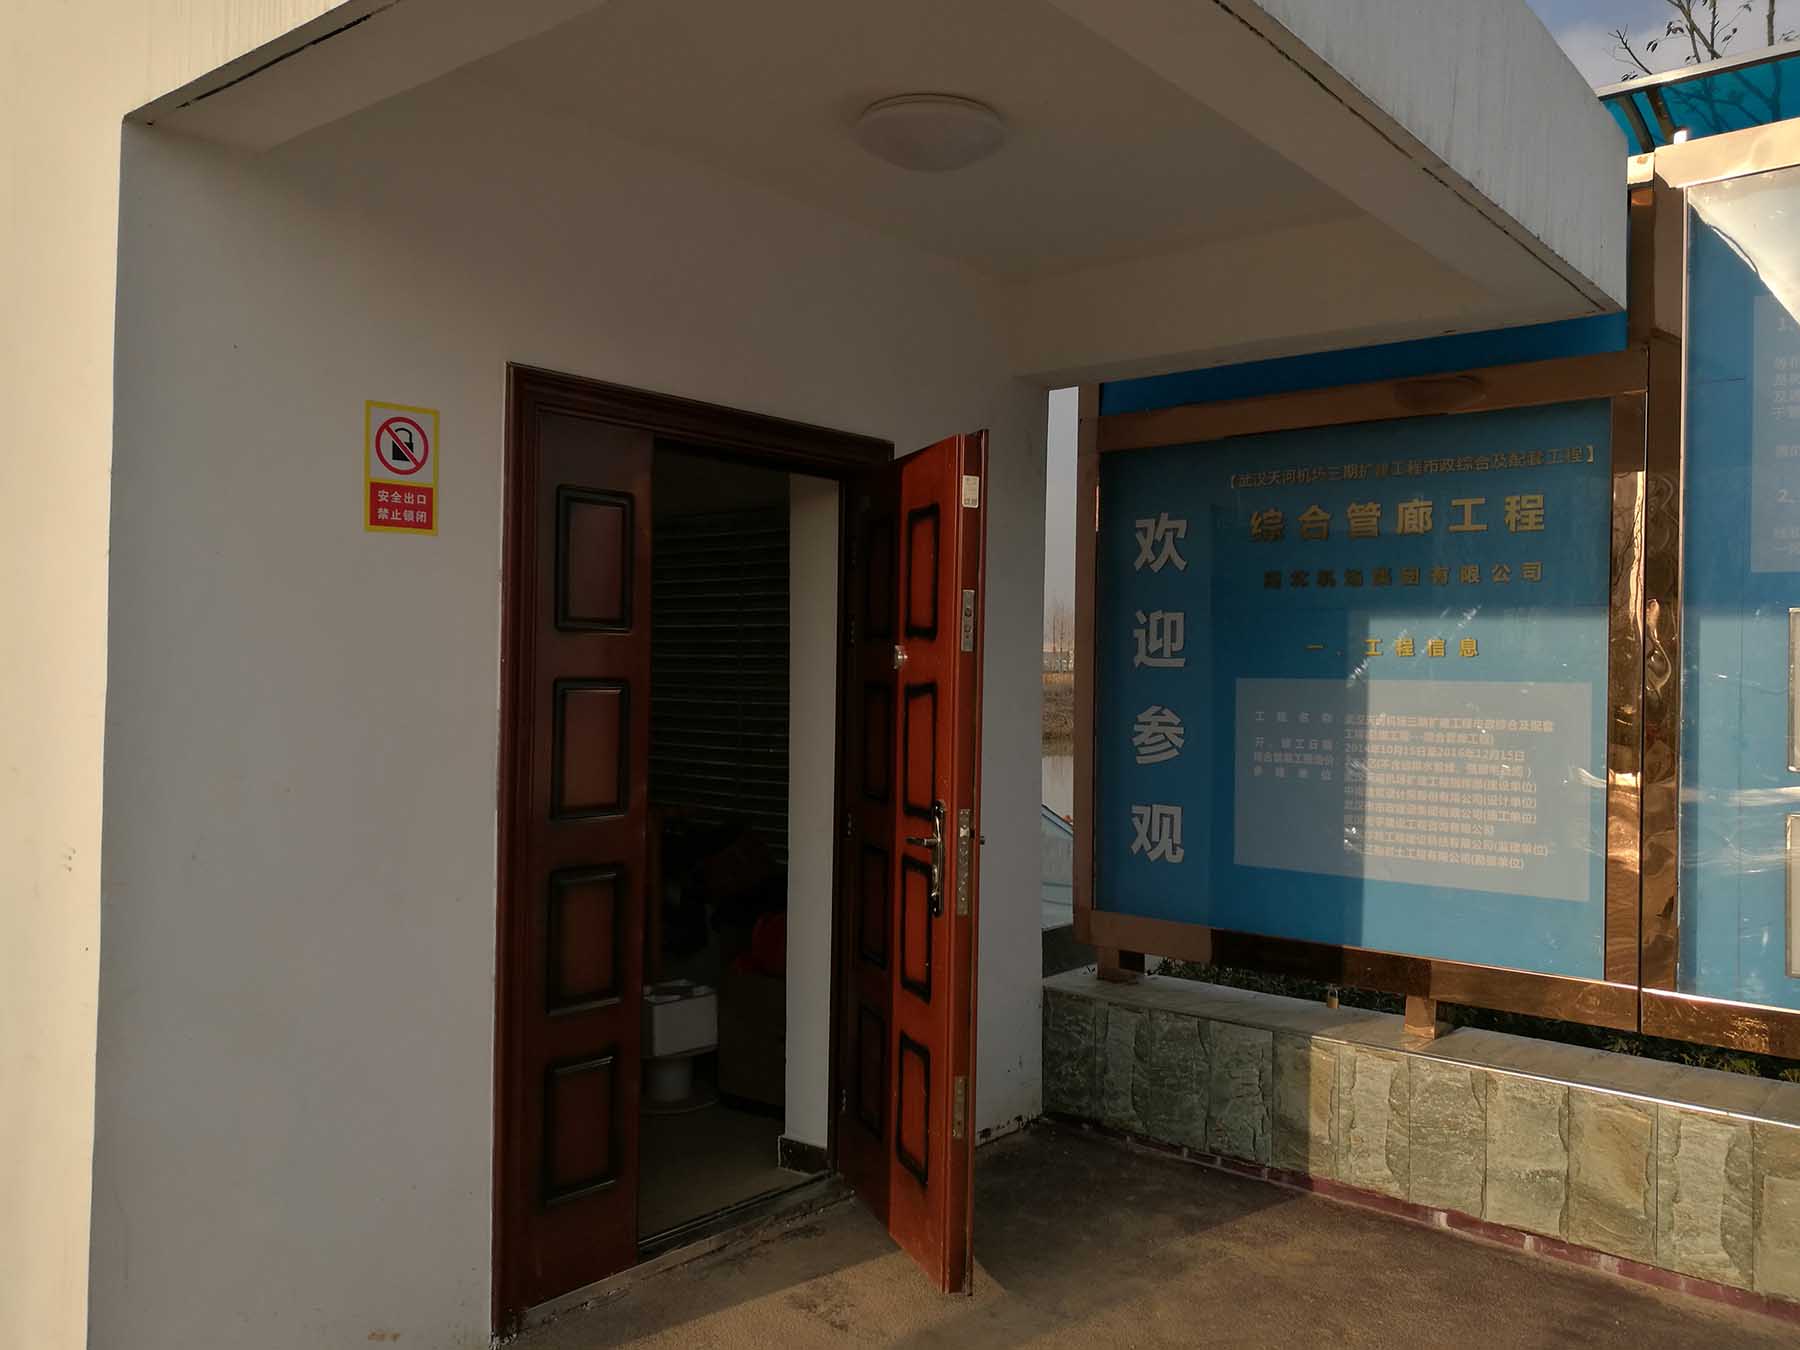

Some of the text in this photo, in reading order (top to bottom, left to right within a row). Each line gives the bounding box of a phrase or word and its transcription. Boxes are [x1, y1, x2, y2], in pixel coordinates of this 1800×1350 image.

[377, 489, 426, 505] 安全出口
[377, 507, 427, 524] 禁止锁闭
[1249, 492, 1545, 541] 综合管廊工程
[1131, 512, 1188, 863] 欢迎参观
